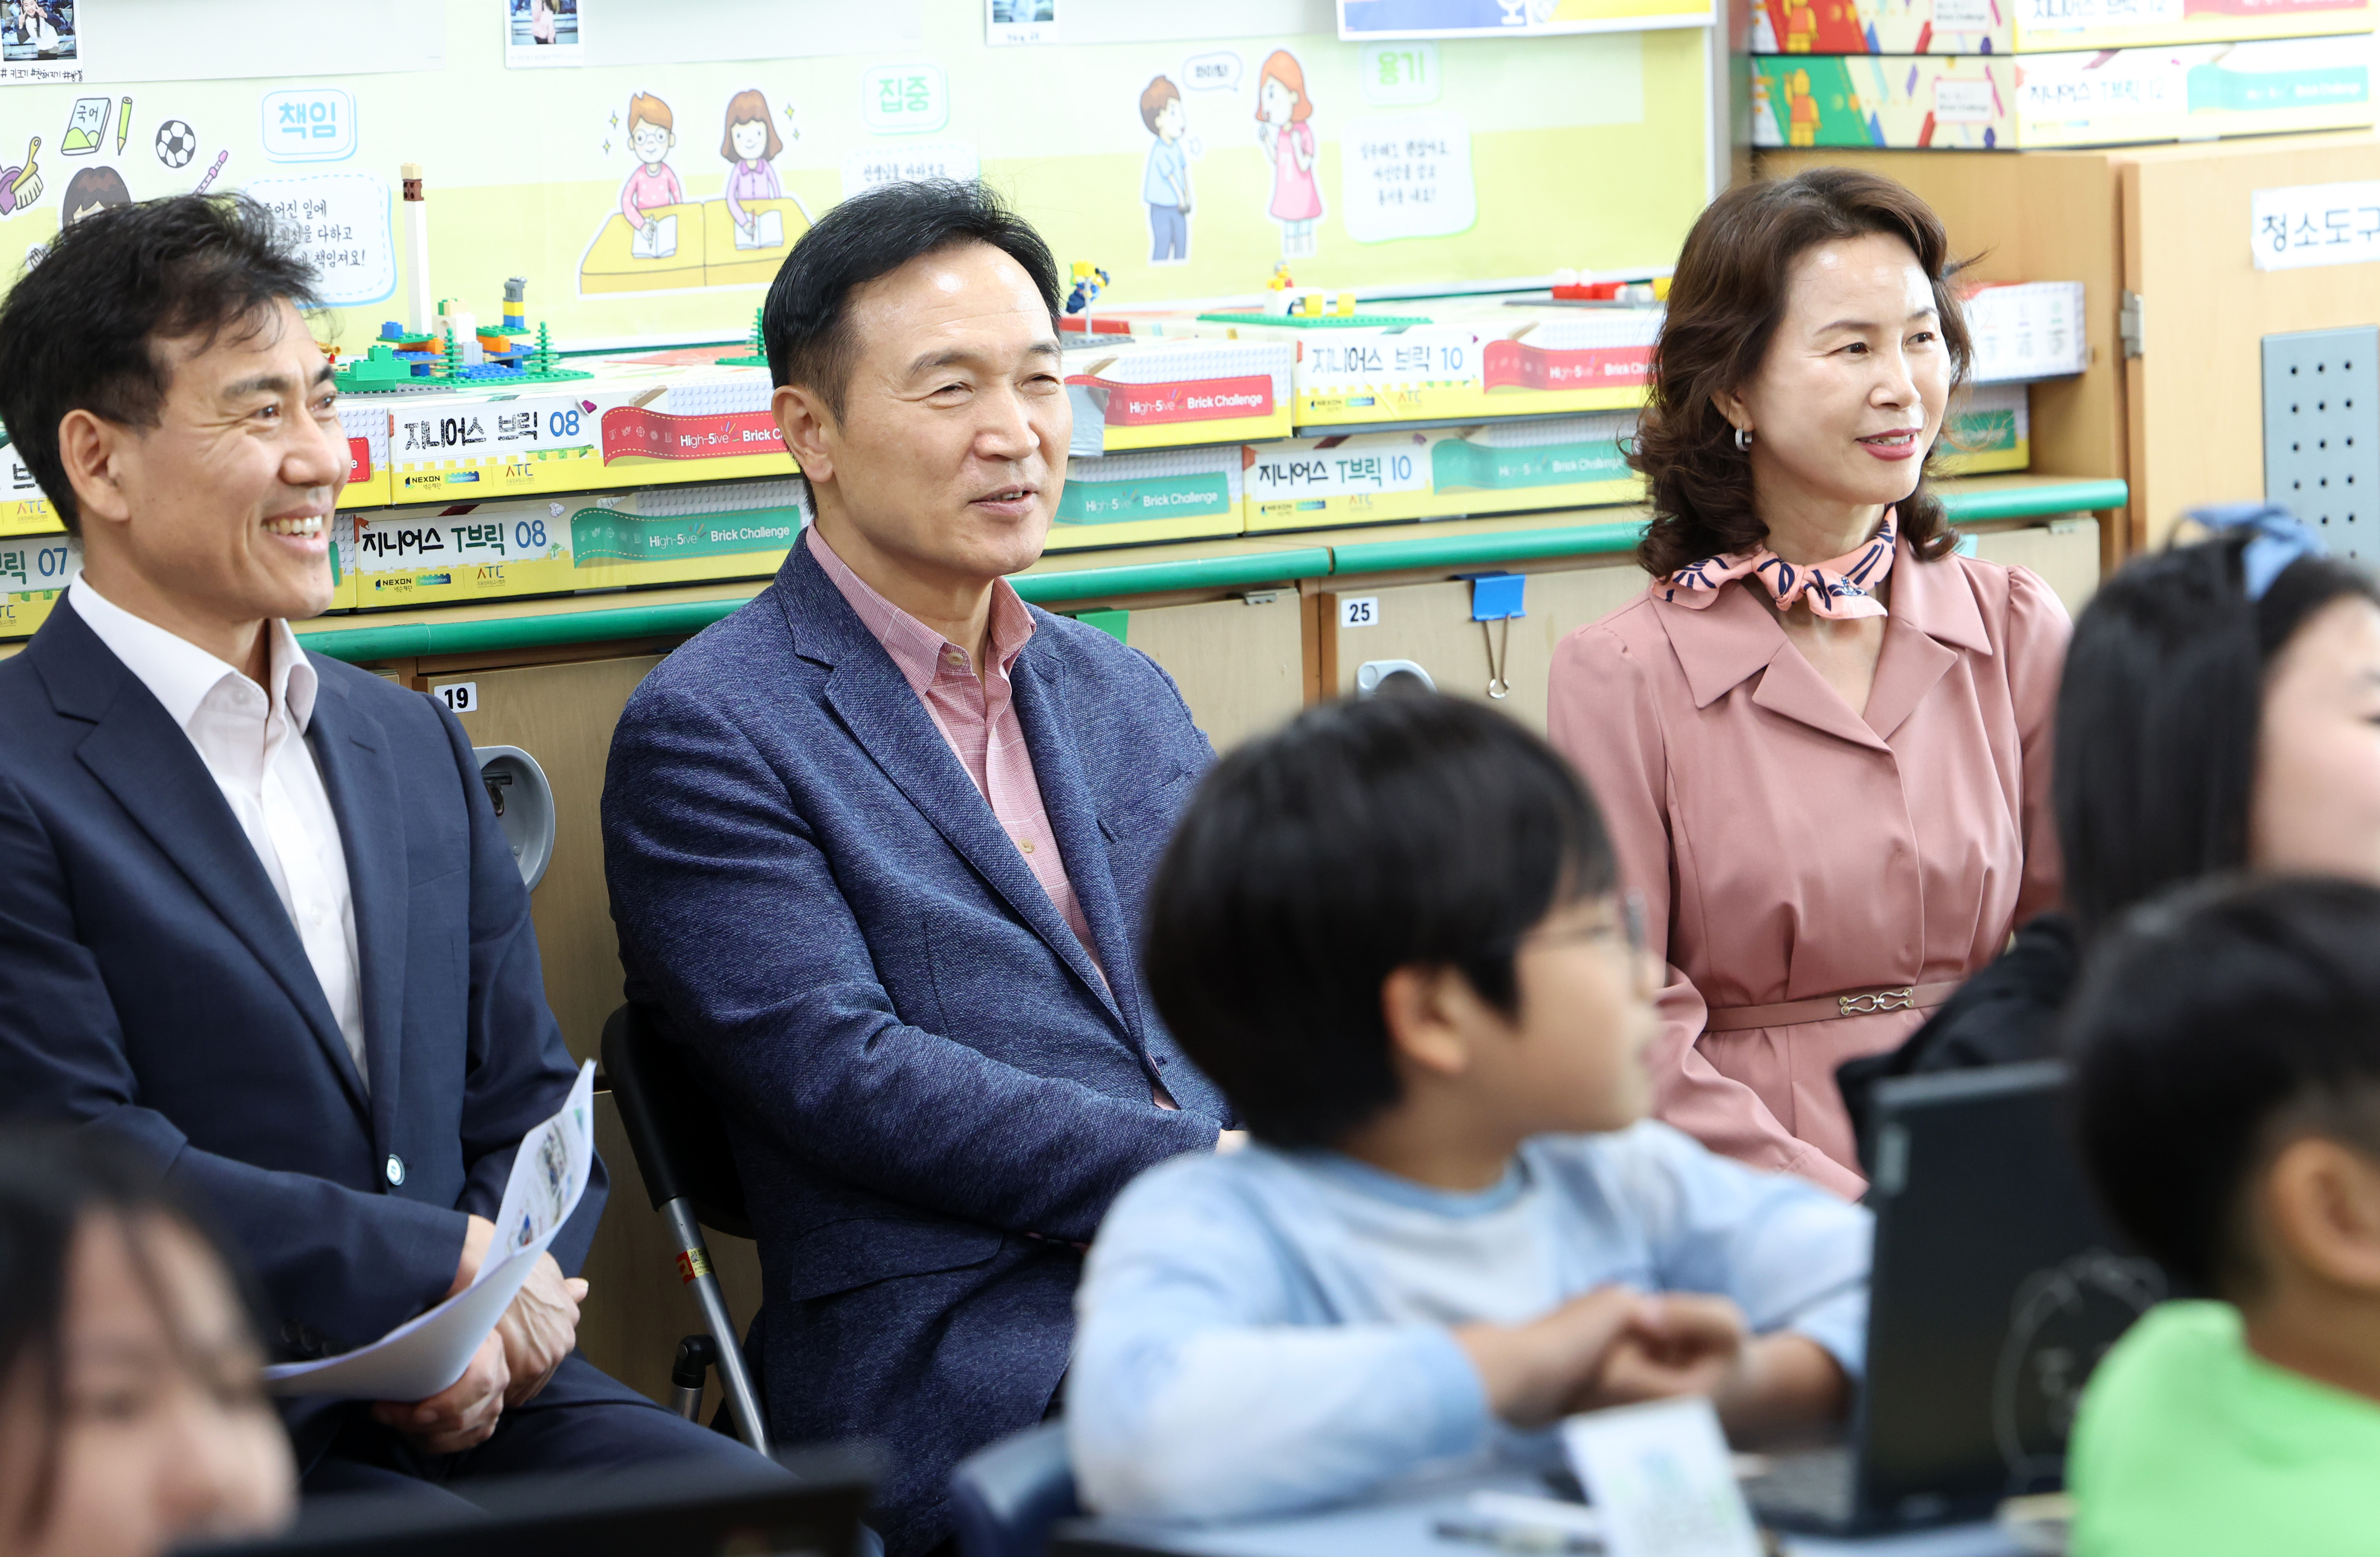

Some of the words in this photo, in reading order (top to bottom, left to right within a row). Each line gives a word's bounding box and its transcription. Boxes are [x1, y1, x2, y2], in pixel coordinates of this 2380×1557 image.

[1378, 51, 1425, 85] 용기
[879, 76, 930, 113] 집중
[2030, 81, 2090, 105] 지니어스
[2149, 77, 2165, 99] 12
[77, 105, 98, 123] 국어
[279, 101, 336, 139] 책임
[303, 199, 326, 219] 일에
[318, 224, 352, 243] 다하고
[2262, 206, 2380, 252] 청소도구
[1312, 347, 1383, 373] 지니어스
[1395, 346, 1430, 372] 브릭
[1441, 347, 1463, 370] 10
[1604, 364, 1630, 376] Brick
[1187, 397, 1213, 409] Brick
[1214, 394, 1262, 408] Challenge
[404, 416, 487, 450] 지니어스
[498, 412, 537, 441] 브릭
[550, 410, 579, 437] 08
[680, 431, 729, 449] High-5ive
[743, 429, 770, 442] Brick
[506, 463, 533, 477] ATC
[1259, 461, 1329, 487] 지니어스
[1335, 456, 1382, 487] T브릭
[1392, 455, 1412, 481] 10
[17, 500, 47, 515] ATC
[1143, 495, 1169, 507] Brick
[1171, 491, 1218, 505] Challenge
[362, 528, 444, 558] 지니어스
[451, 523, 505, 556] T브릭
[515, 520, 546, 548] 08
[649, 533, 697, 550] High-5ive
[711, 529, 738, 542] Brick
[740, 526, 790, 541] Challenge
[38, 547, 67, 577] 07
[383, 578, 411, 586] NEXON
[477, 566, 505, 580] ATC
[1350, 603, 1370, 622] 25
[444, 688, 468, 710] 19
